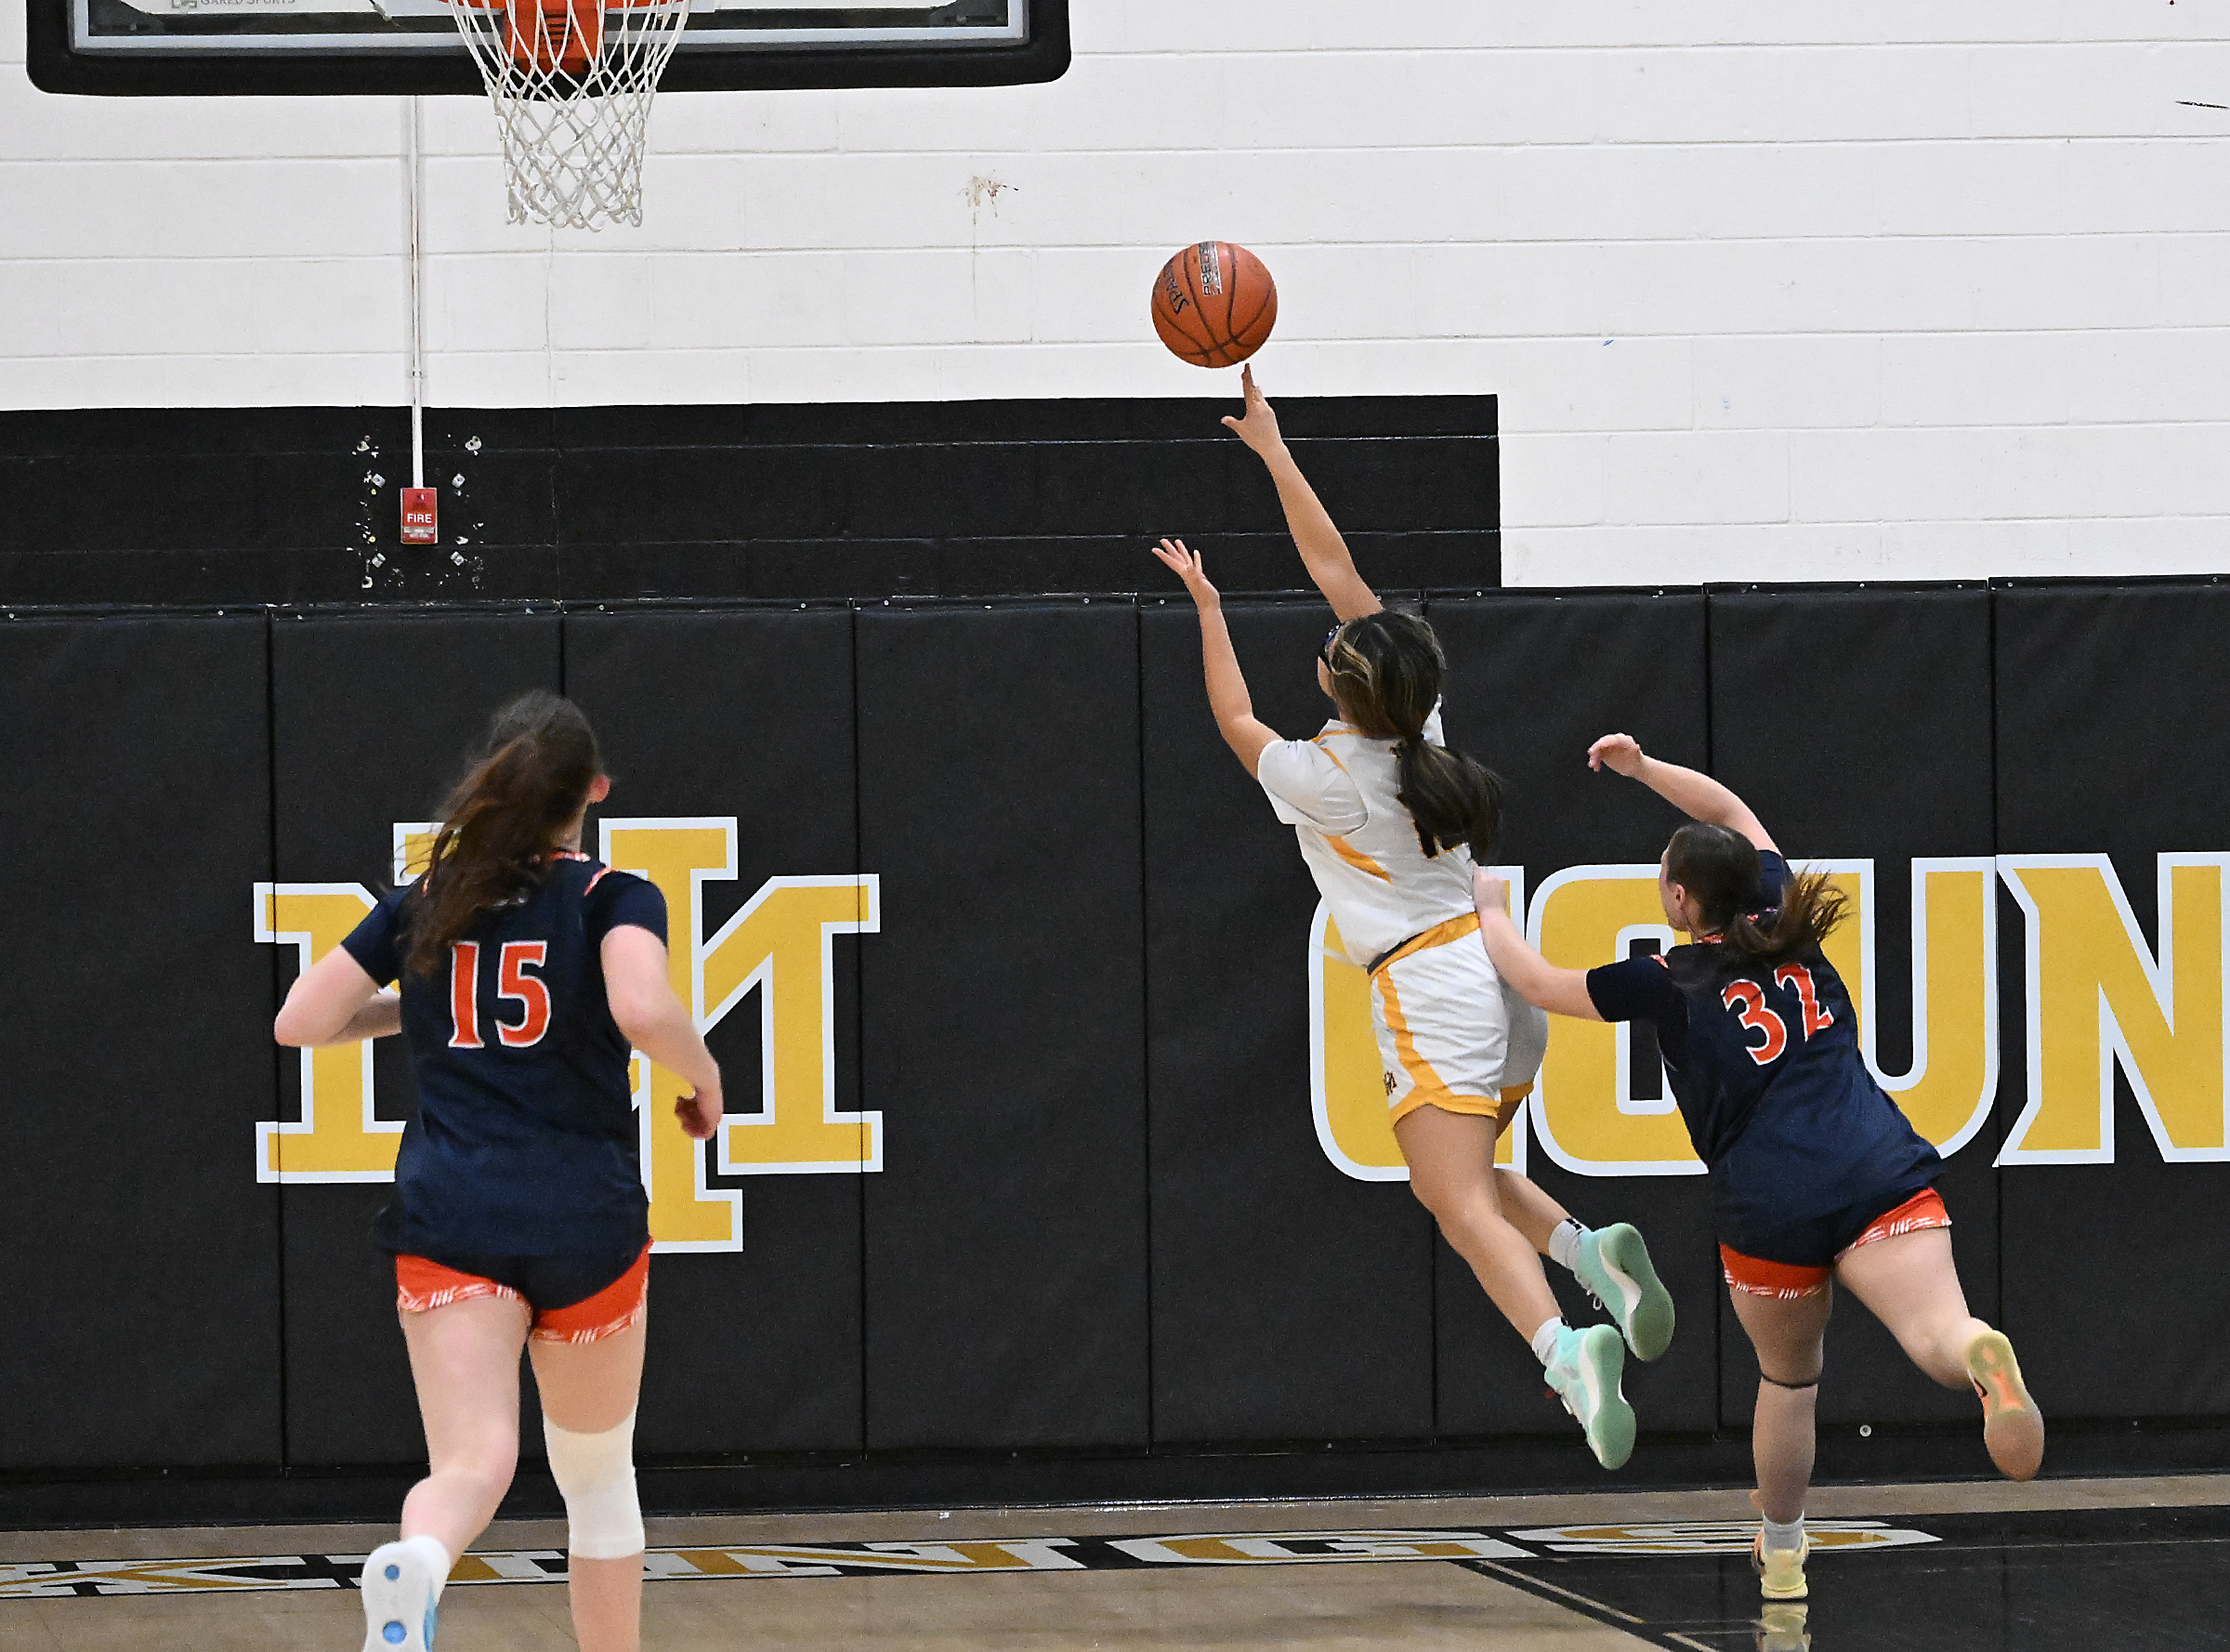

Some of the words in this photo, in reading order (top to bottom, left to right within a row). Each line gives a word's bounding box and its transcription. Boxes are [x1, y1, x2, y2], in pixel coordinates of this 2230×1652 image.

[407, 513, 432, 524] FIRE
[447, 938, 552, 1050] 15
[1720, 962, 1835, 1066] 32
